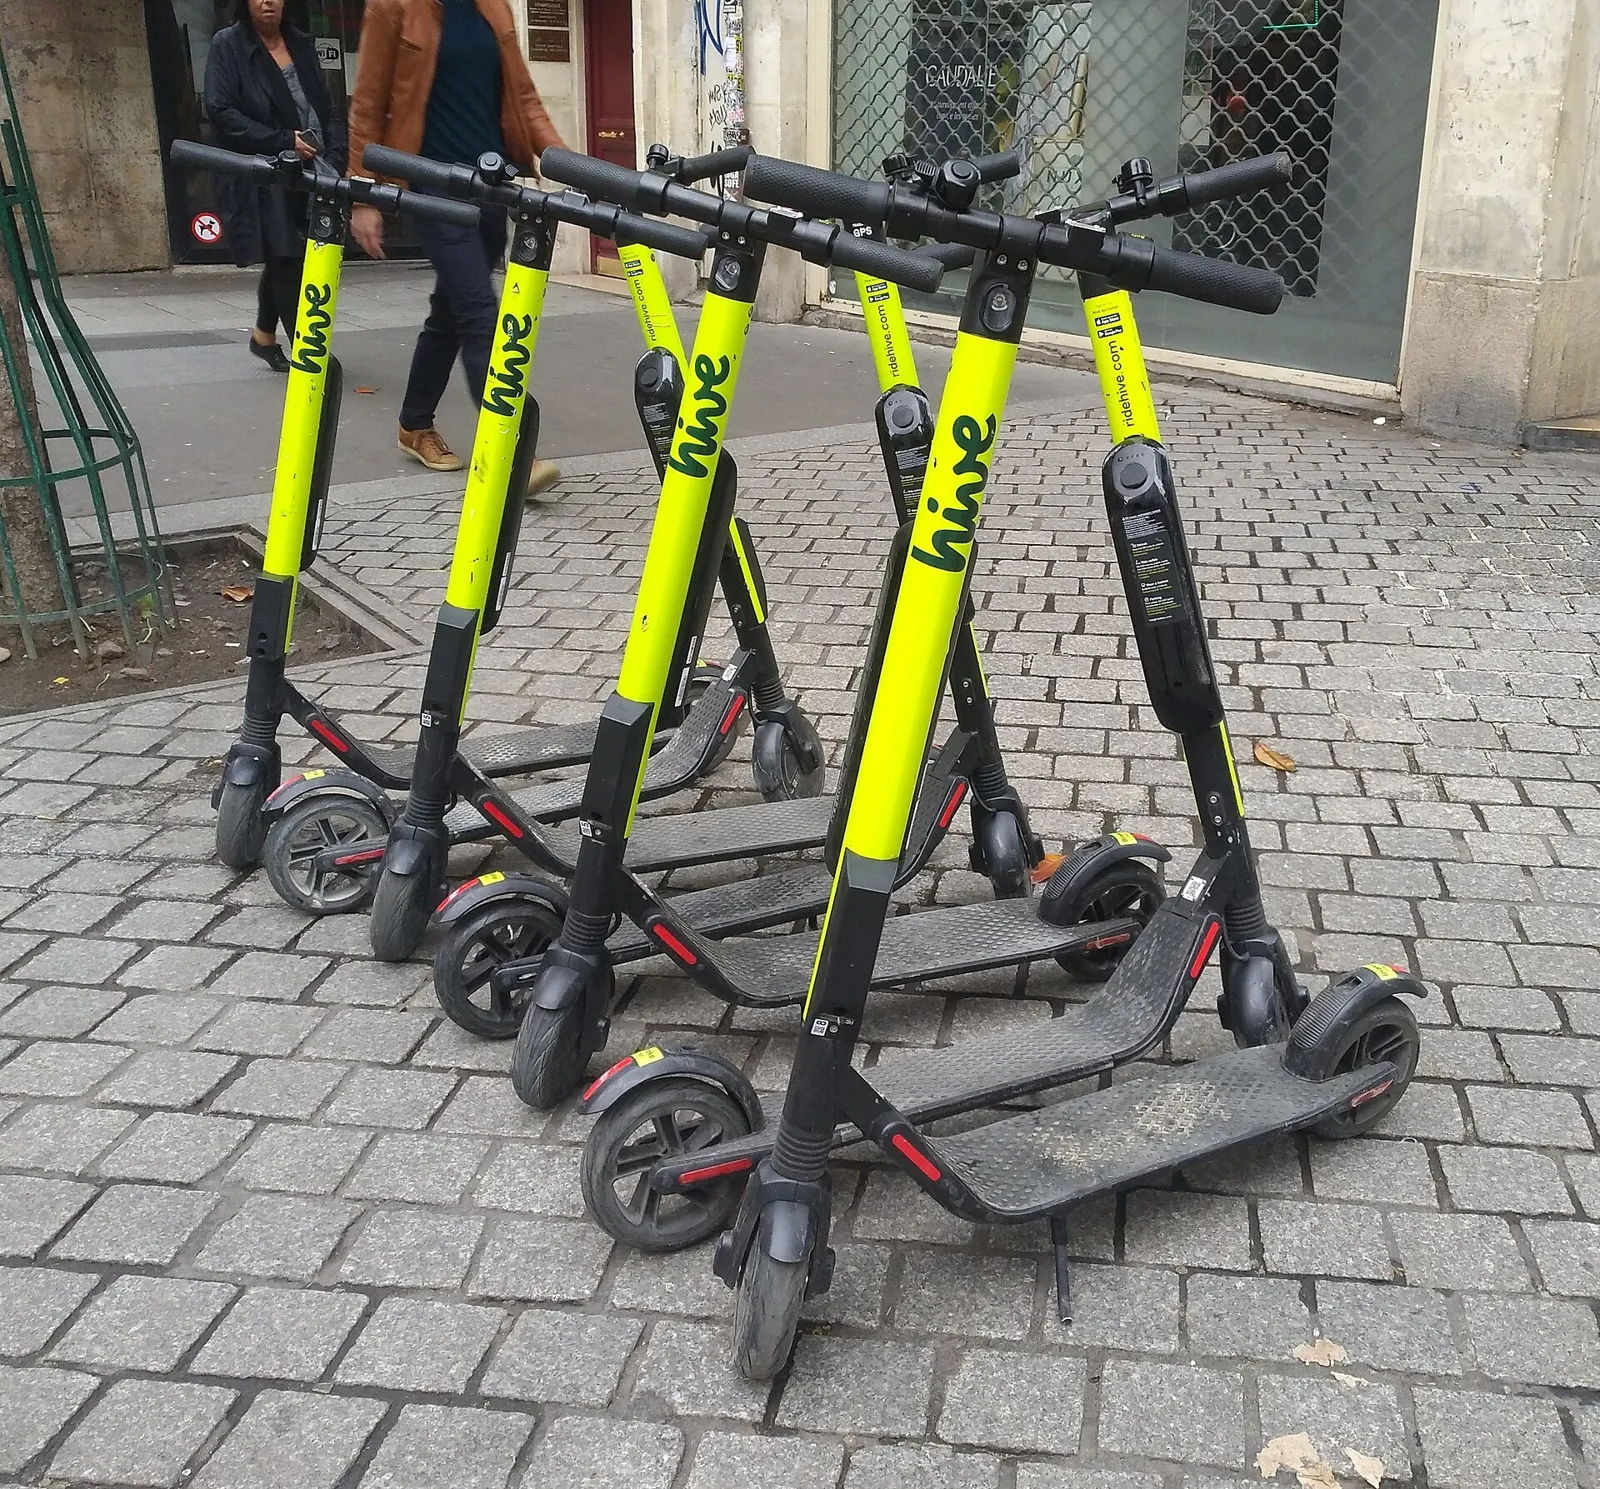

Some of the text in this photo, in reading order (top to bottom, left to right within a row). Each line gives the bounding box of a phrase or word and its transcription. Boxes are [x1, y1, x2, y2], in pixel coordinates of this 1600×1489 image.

[925, 65, 996, 87] CAUDALE
[853, 225, 873, 238] GPS
[291, 284, 331, 374] hive
[634, 279, 657, 342] ridehive.com
[877, 304, 900, 378] ridehive.com
[482, 313, 532, 417] hive
[1108, 340, 1135, 428] ridehive.com
[668, 354, 731, 478] hive
[911, 413, 997, 573] hive
